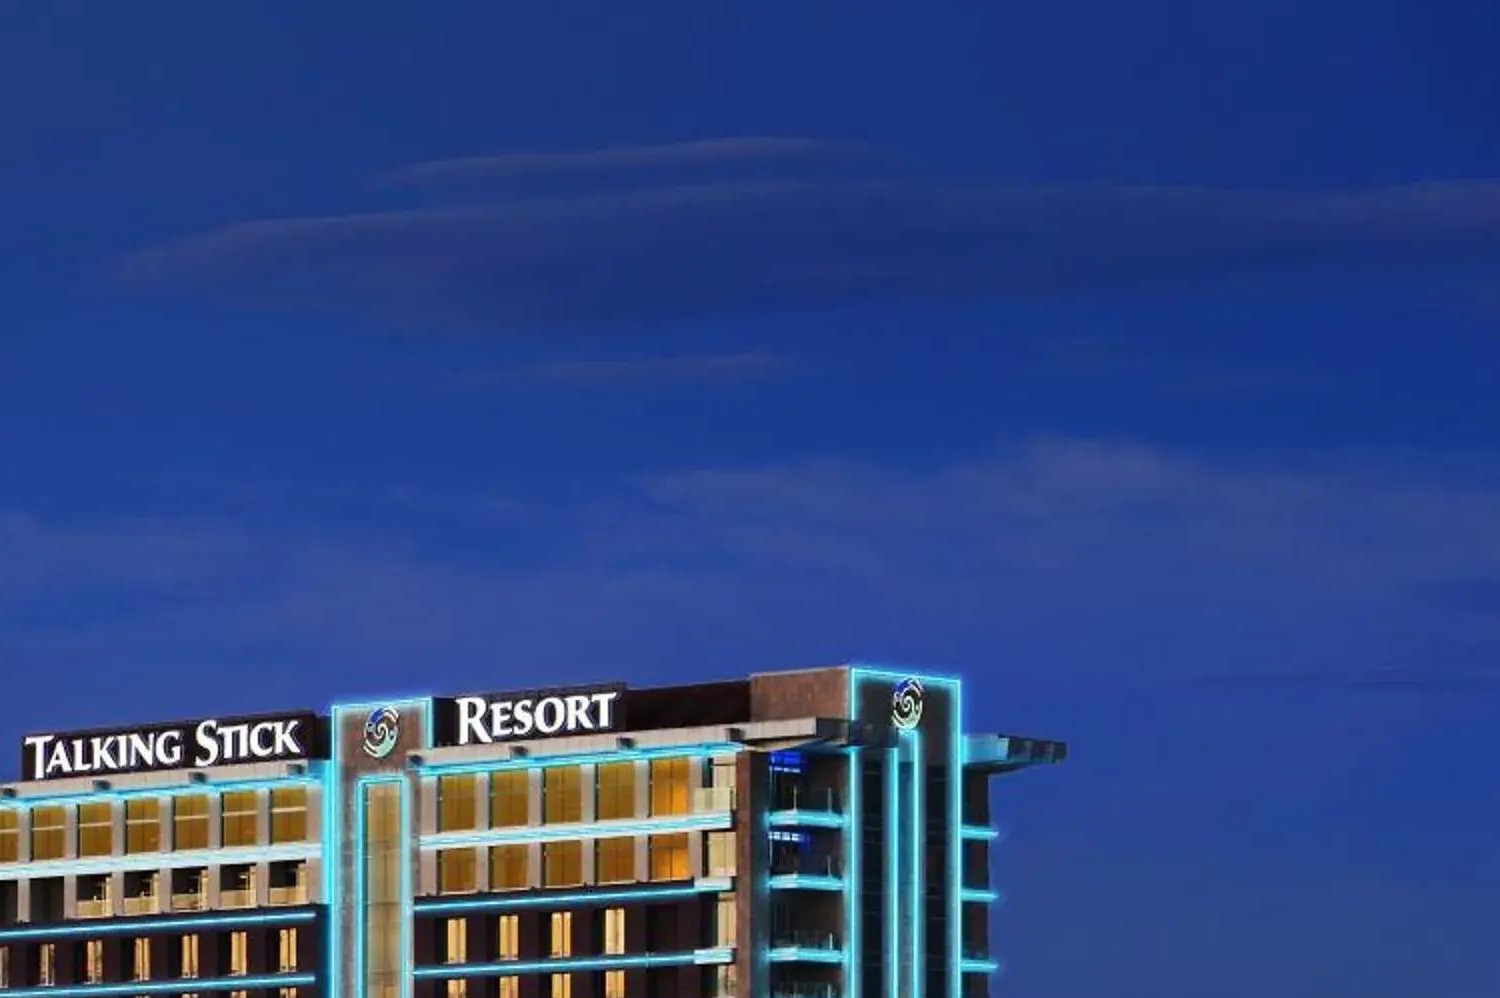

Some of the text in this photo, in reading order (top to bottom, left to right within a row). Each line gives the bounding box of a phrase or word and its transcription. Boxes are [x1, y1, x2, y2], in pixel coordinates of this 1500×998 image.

[25, 692, 617, 780] TALKING STICK RESORT
